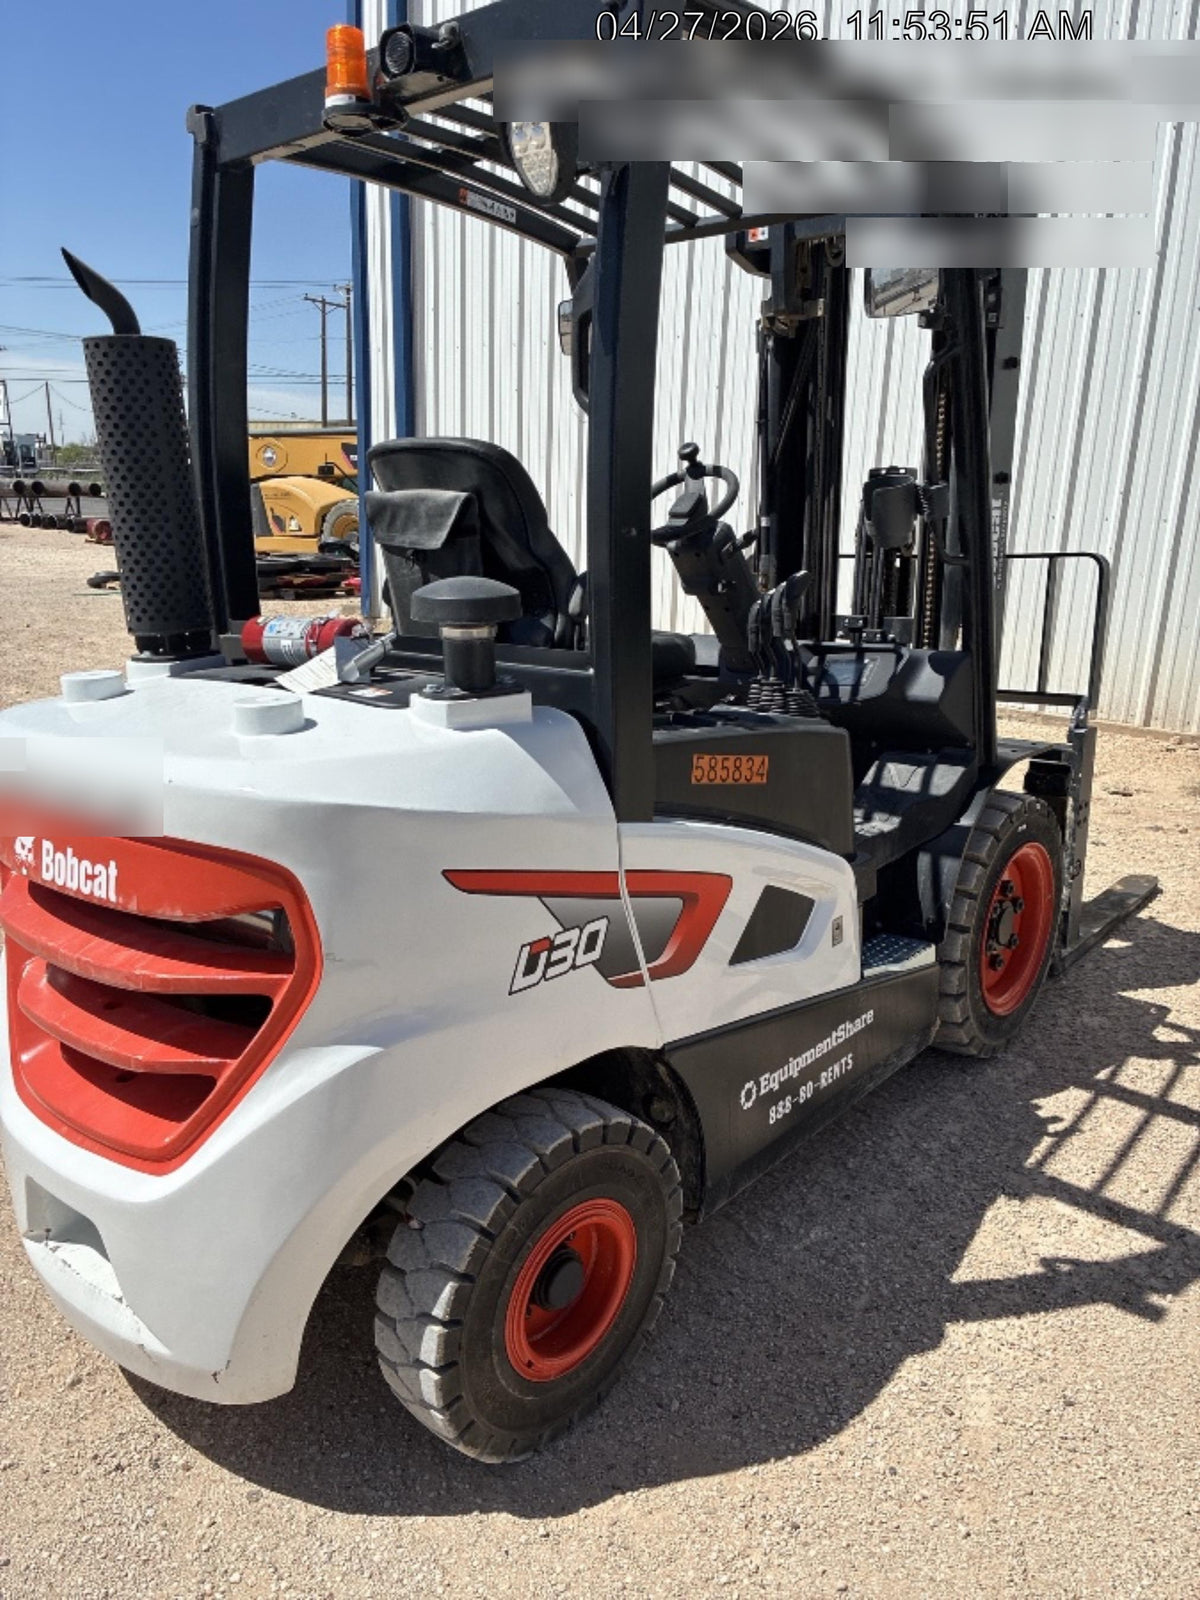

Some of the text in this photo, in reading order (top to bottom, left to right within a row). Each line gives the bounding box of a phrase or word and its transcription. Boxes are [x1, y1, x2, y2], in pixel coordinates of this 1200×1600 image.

[693, 756, 766, 783] 585834
[41, 838, 118, 903] Bobcat
[508, 915, 610, 995] D30
[758, 1009, 874, 1096] EquipmentShare
